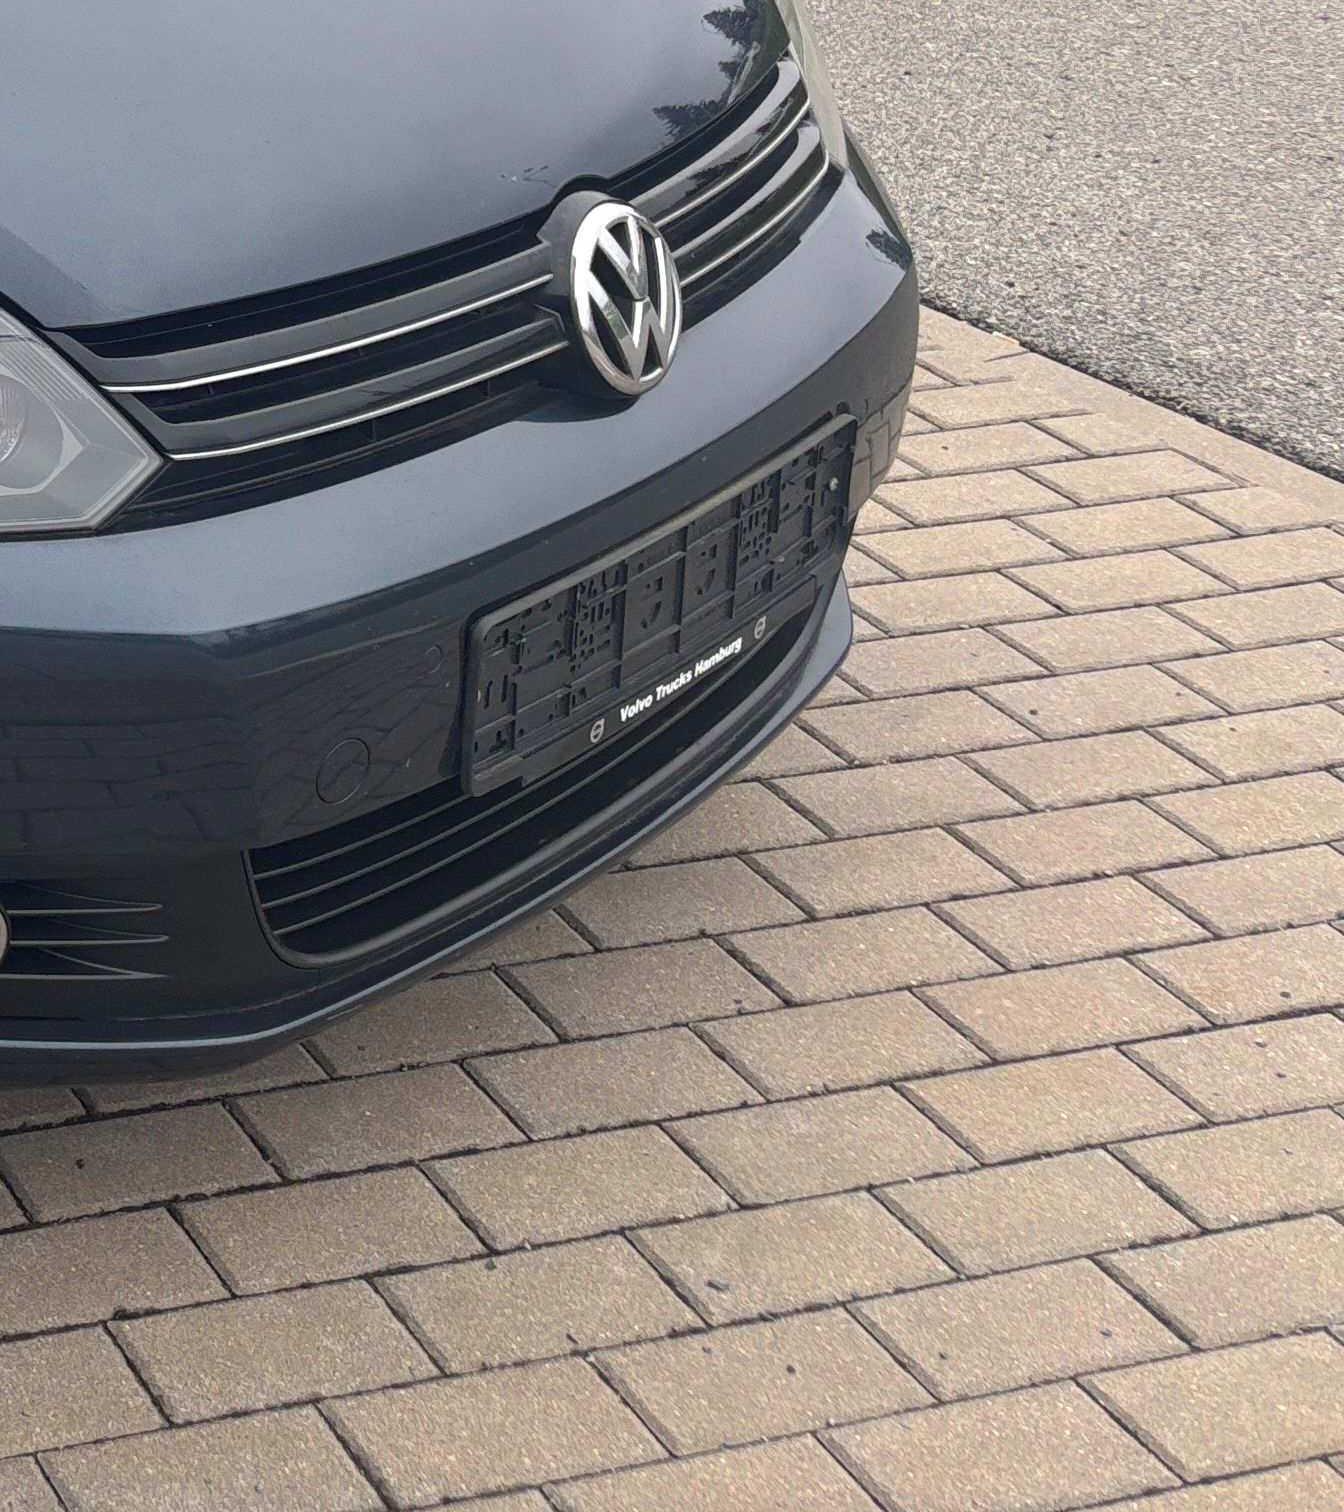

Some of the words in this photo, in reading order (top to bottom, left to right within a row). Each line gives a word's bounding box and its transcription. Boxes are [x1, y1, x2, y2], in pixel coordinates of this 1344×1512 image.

[620, 694, 653, 722] Volvo
[655, 669, 692, 700] Trucks
[694, 637, 743, 678] Hamburg
